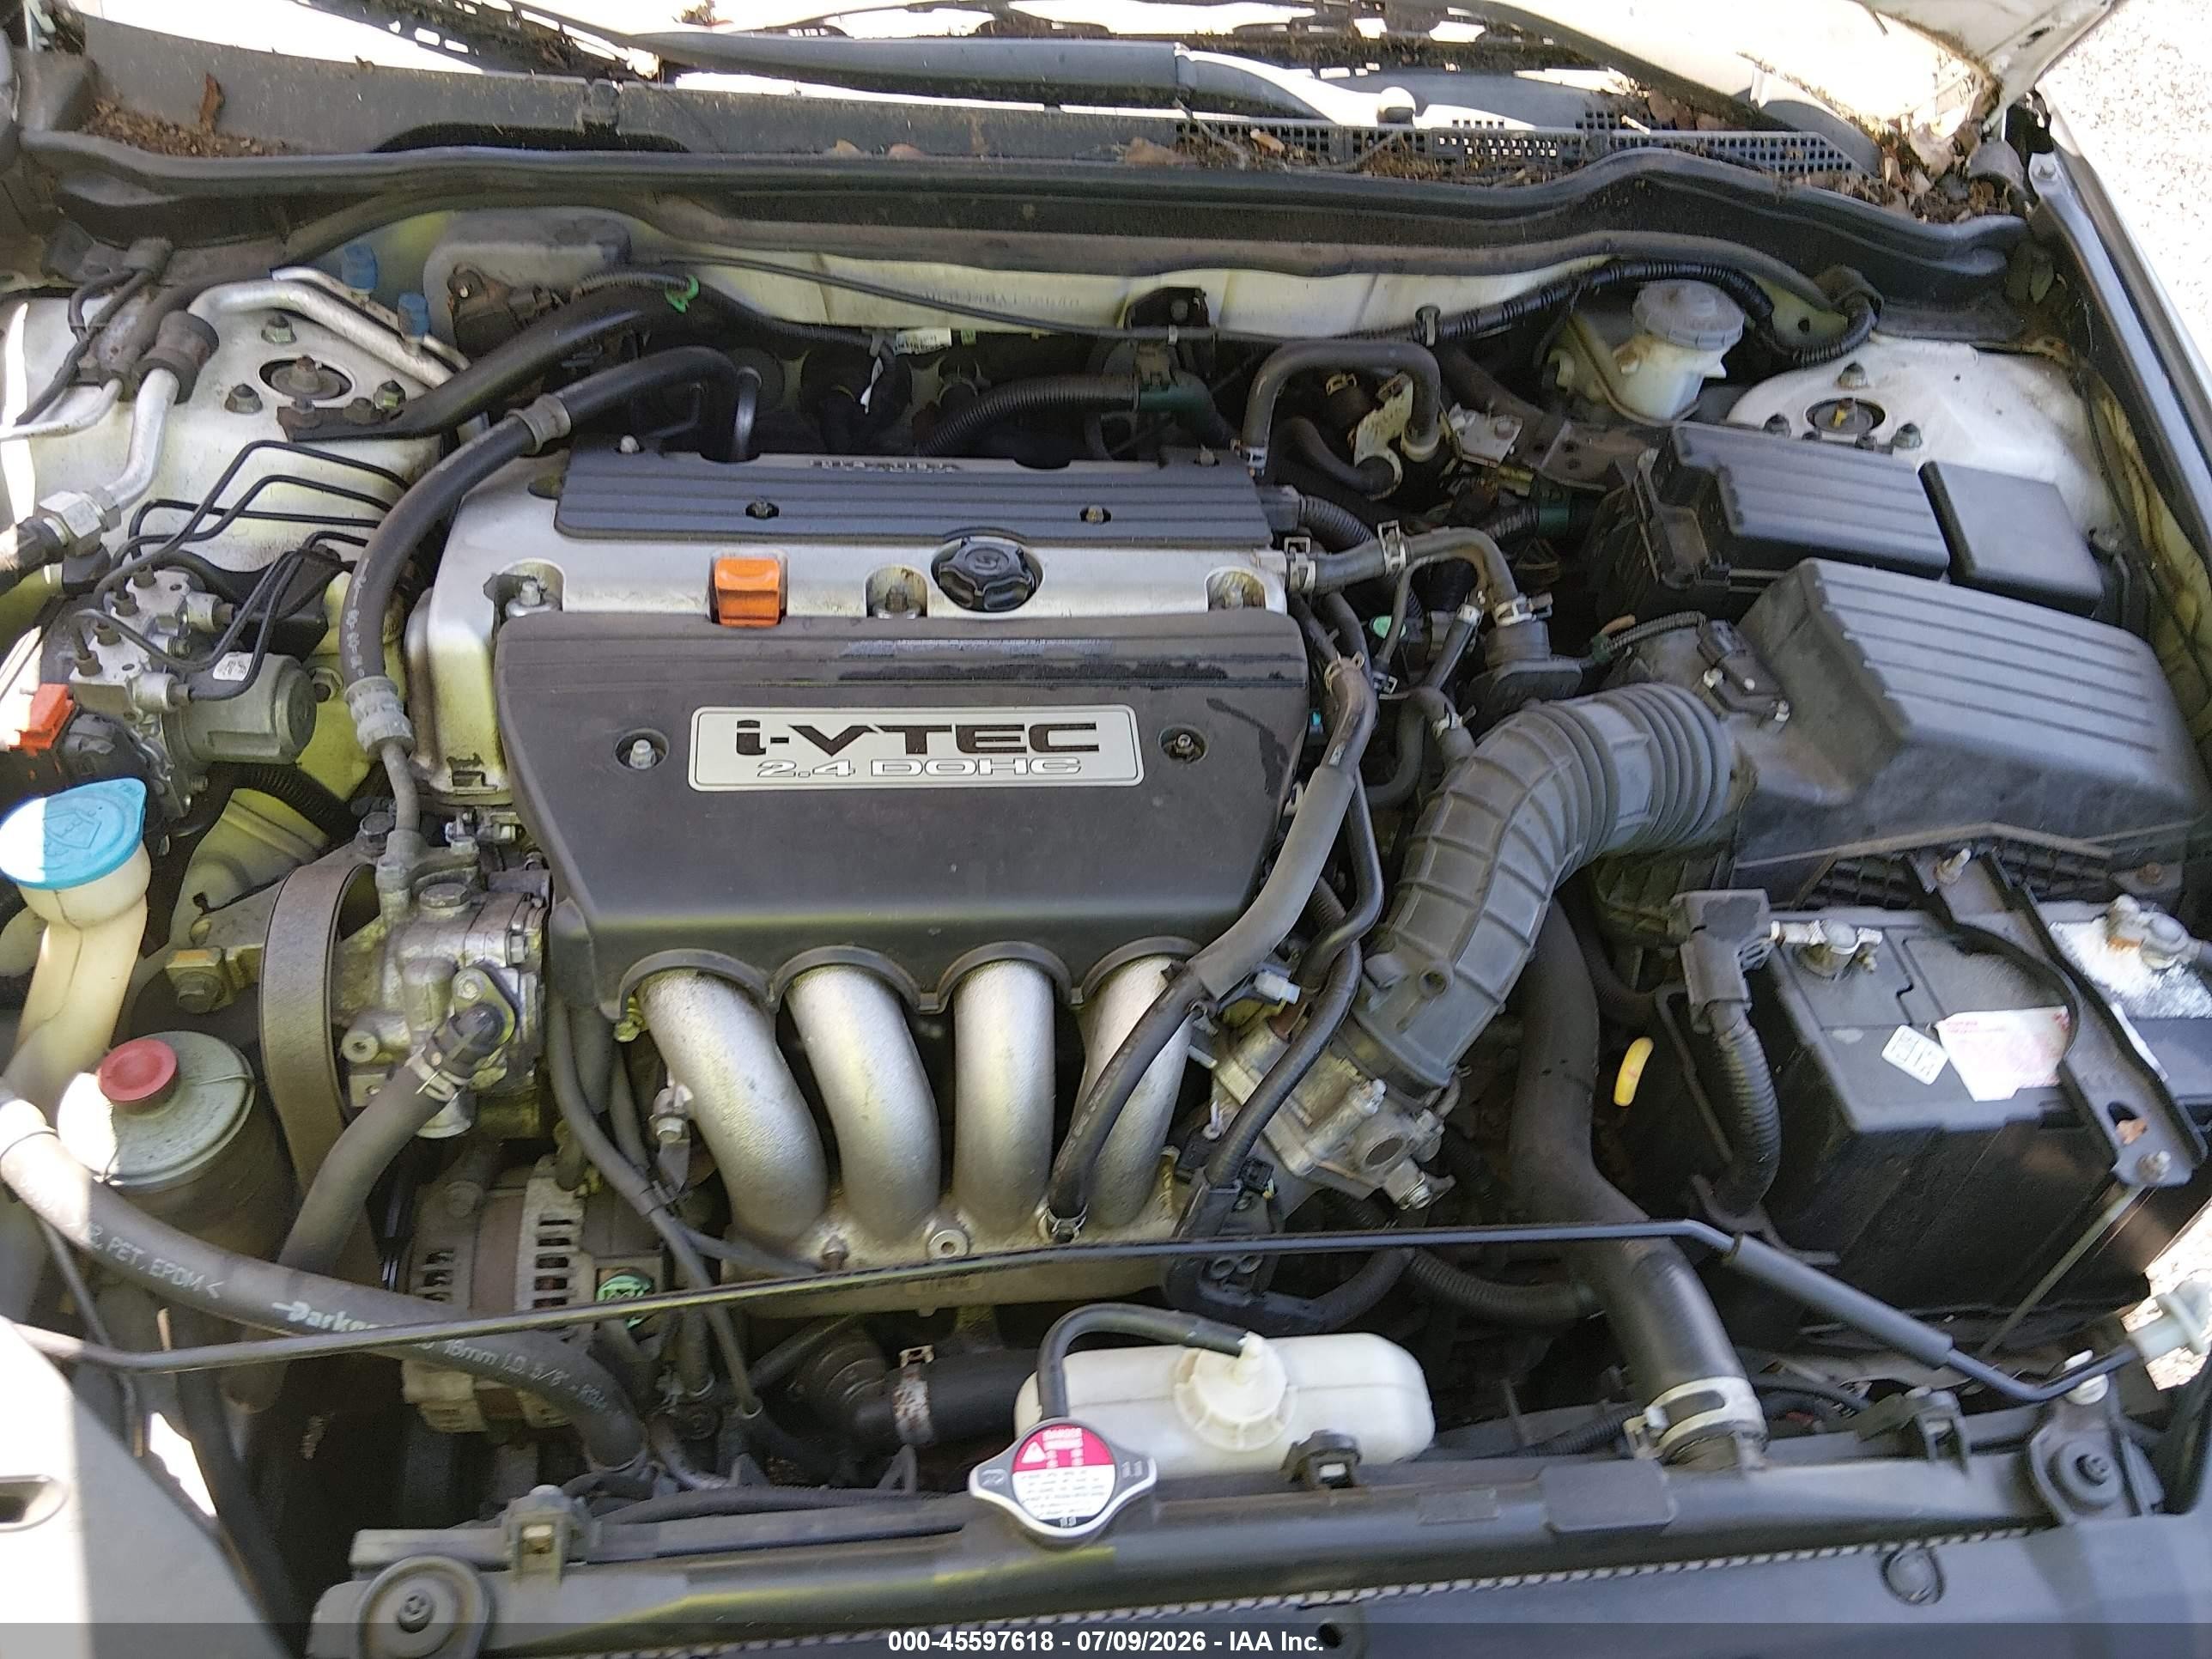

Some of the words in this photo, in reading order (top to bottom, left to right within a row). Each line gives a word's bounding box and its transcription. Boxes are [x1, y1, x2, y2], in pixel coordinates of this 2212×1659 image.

[737, 720, 1100, 757] i-VTEC
[757, 758, 857, 777] 2.4
[870, 757, 1082, 777] DOHC
